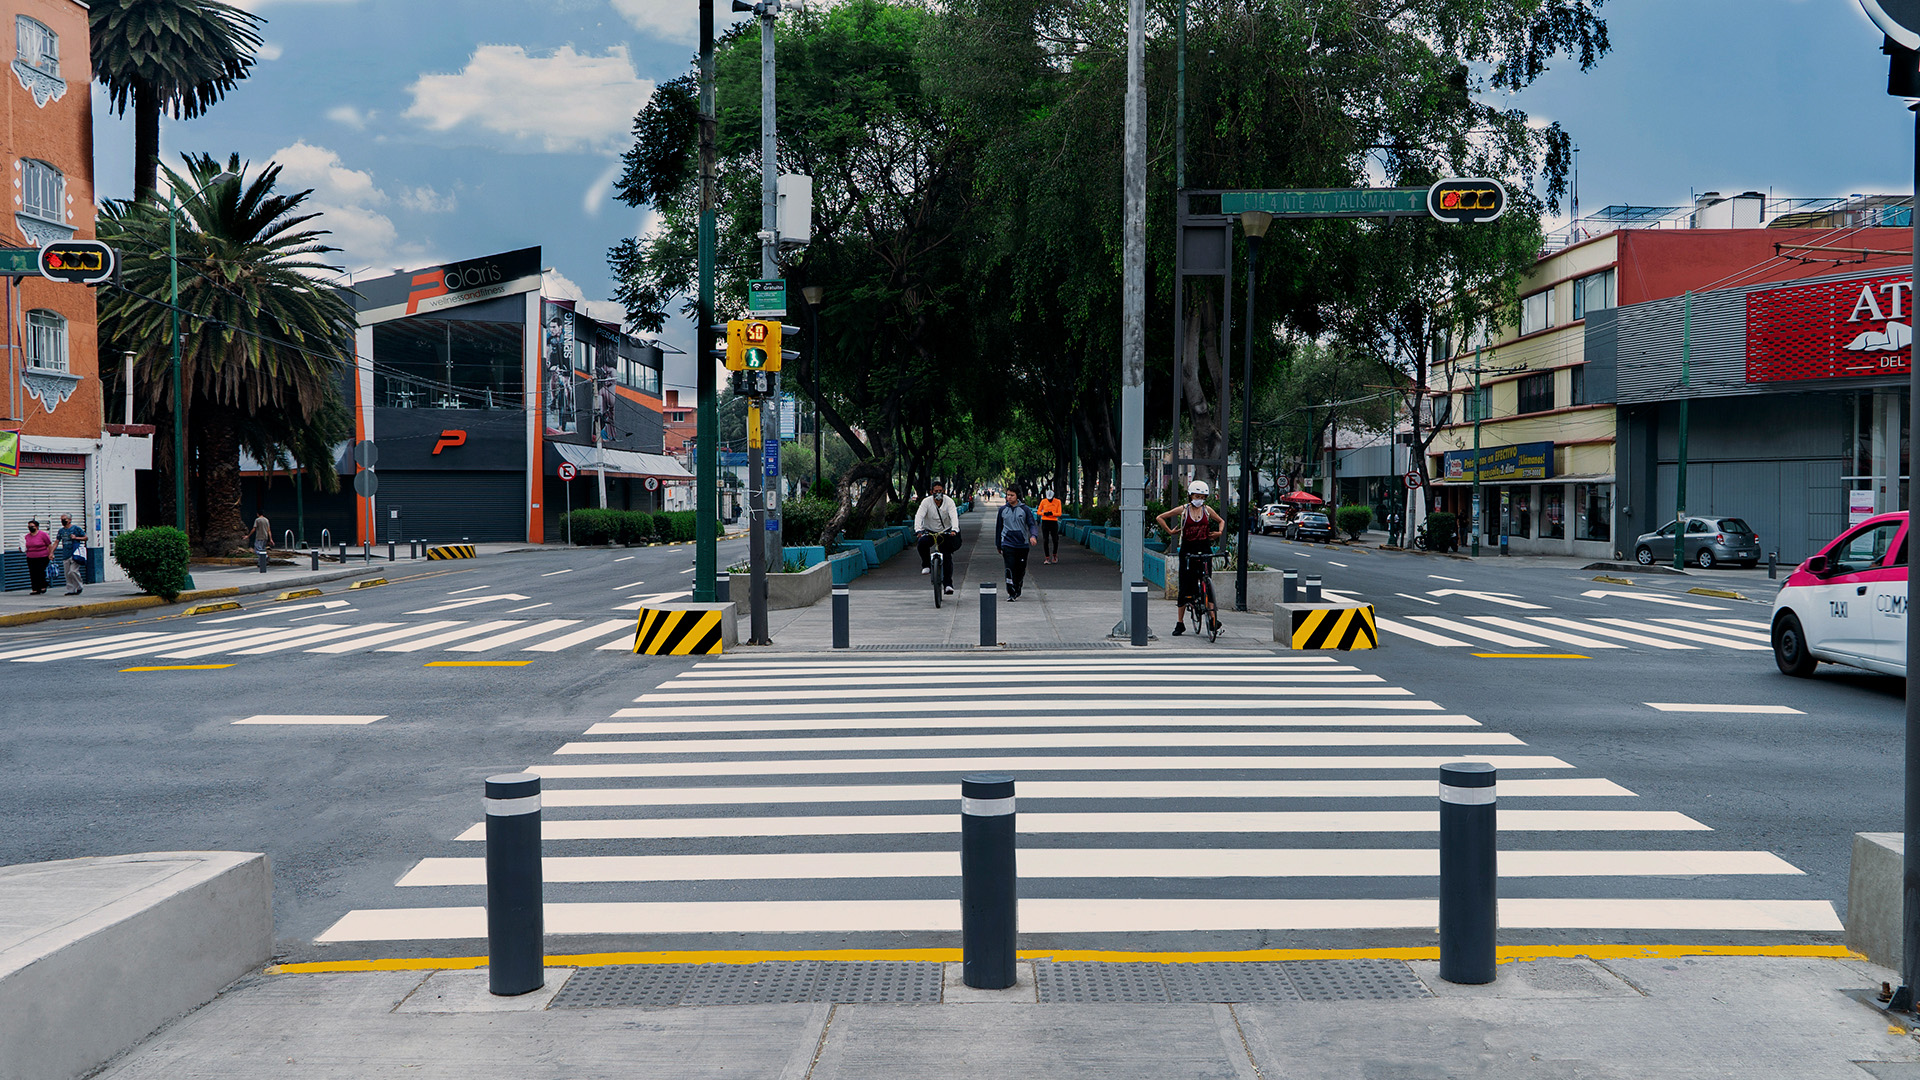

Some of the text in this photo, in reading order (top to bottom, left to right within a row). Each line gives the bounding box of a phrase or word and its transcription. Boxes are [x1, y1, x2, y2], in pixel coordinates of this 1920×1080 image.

[1244, 193, 1396, 209] EJE 4 NTE AV TALISMAN
[405, 260, 502, 315] Polaris
[429, 286, 505, 308] wellnessandfitness
[563, 312, 573, 359] SPINNING
[596, 327, 620, 343] PESAS
[1880, 356, 1905, 368] DEL
[41, 454, 81, 465] INDUSTRIAL
[1495, 446, 1518, 461] EFECTIVO
[1829, 601, 1849, 618] TAXI
